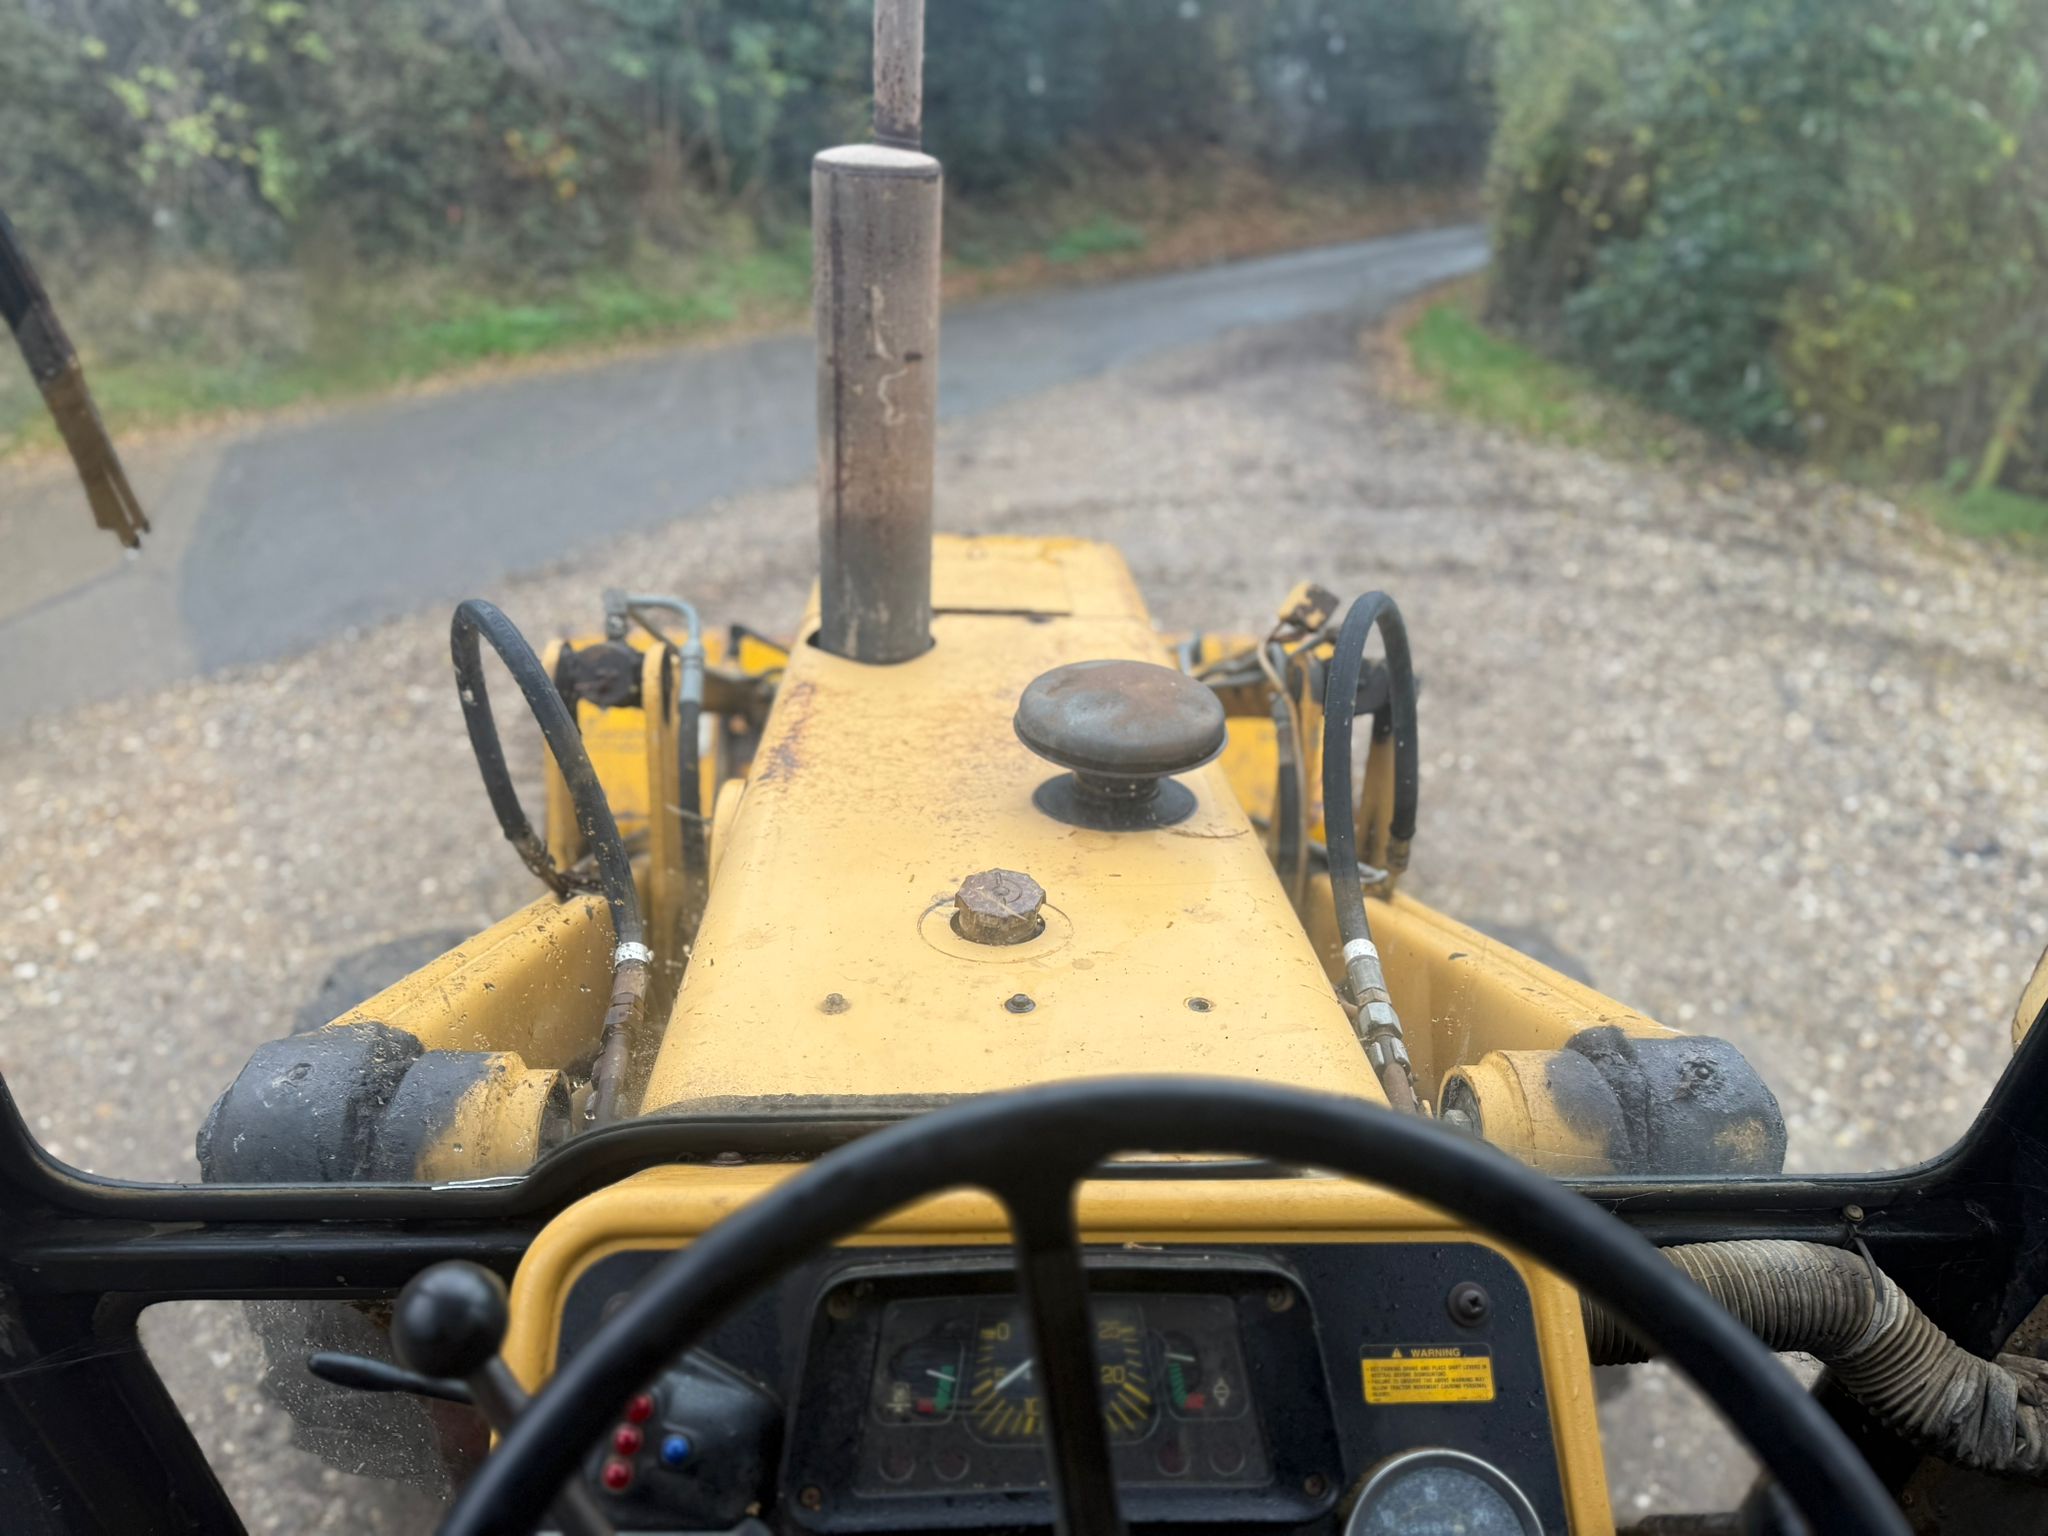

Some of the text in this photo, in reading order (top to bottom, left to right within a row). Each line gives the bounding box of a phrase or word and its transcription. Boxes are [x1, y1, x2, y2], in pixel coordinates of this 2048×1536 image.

[996, 1321, 1010, 1341] 0
[1410, 1347, 1461, 1358] WARNING
[1101, 1365, 1125, 1384] 20
